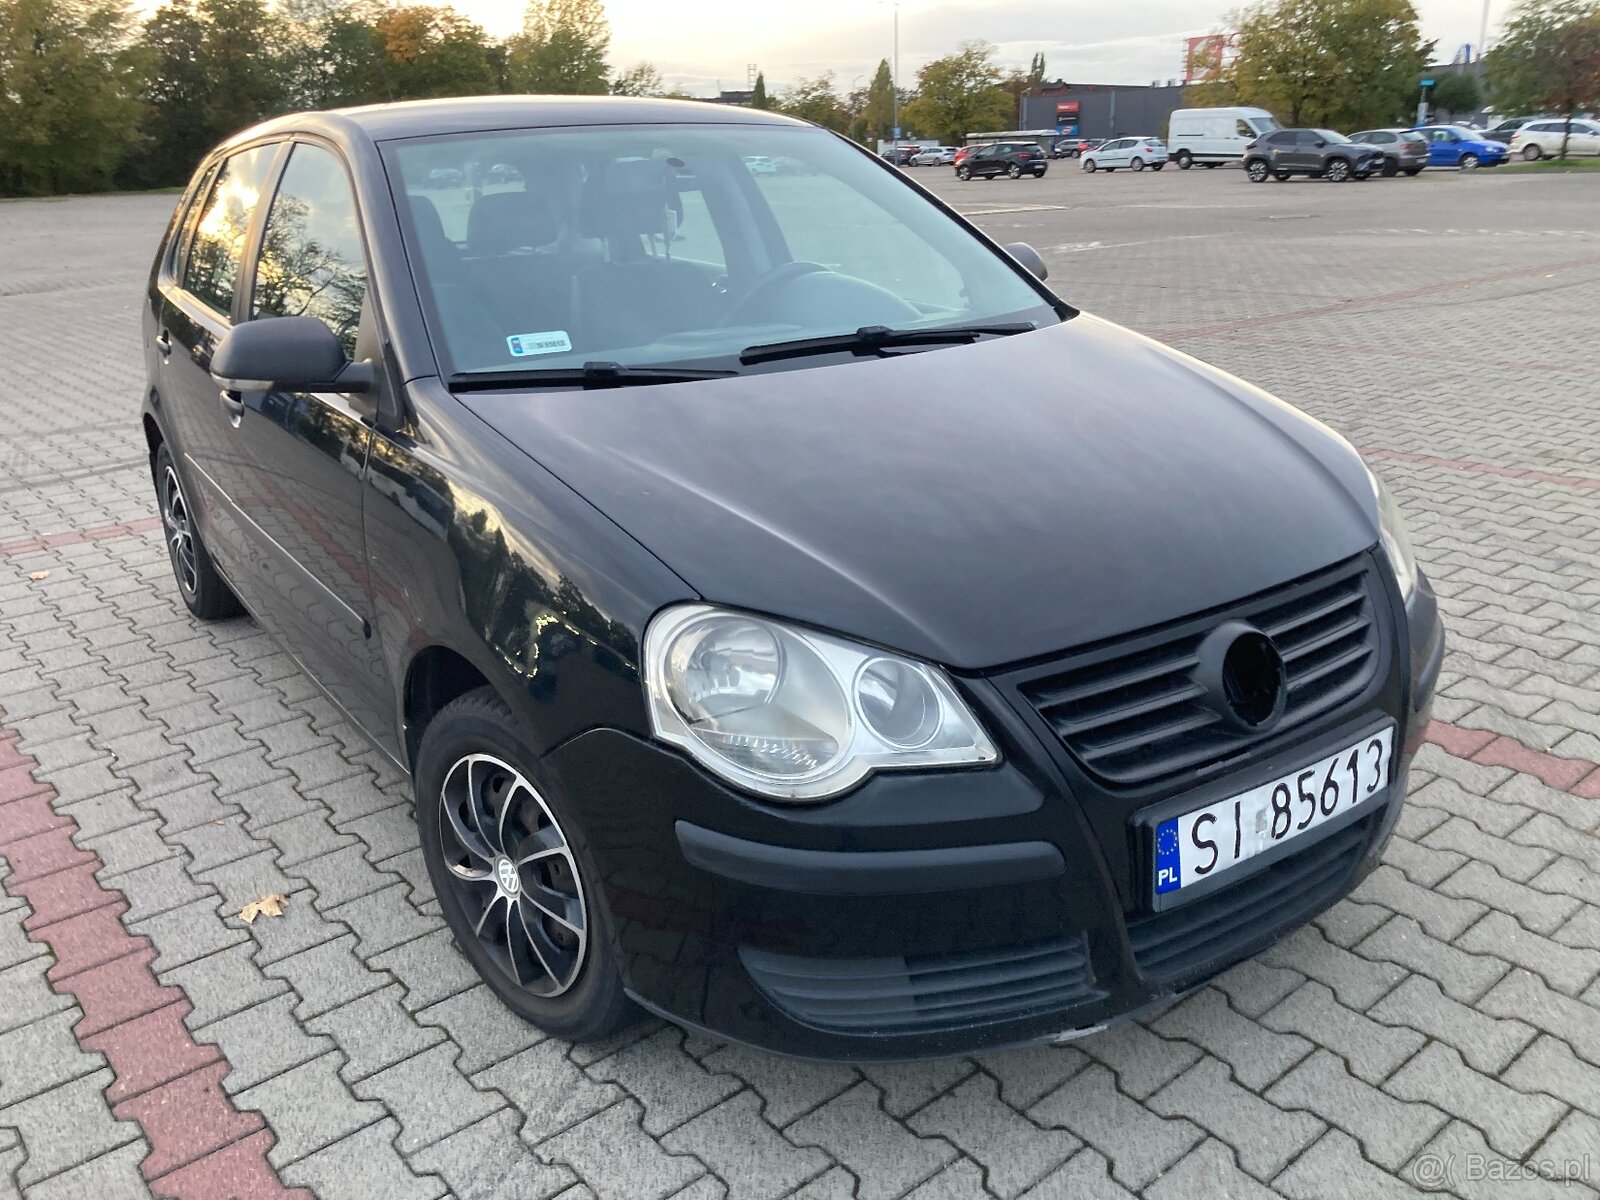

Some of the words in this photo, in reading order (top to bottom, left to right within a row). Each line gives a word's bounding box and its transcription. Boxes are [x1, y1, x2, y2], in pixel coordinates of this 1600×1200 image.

[1191, 801, 1241, 875] SI
[1270, 738, 1383, 840] 85613
[1158, 867, 1178, 886] PL
